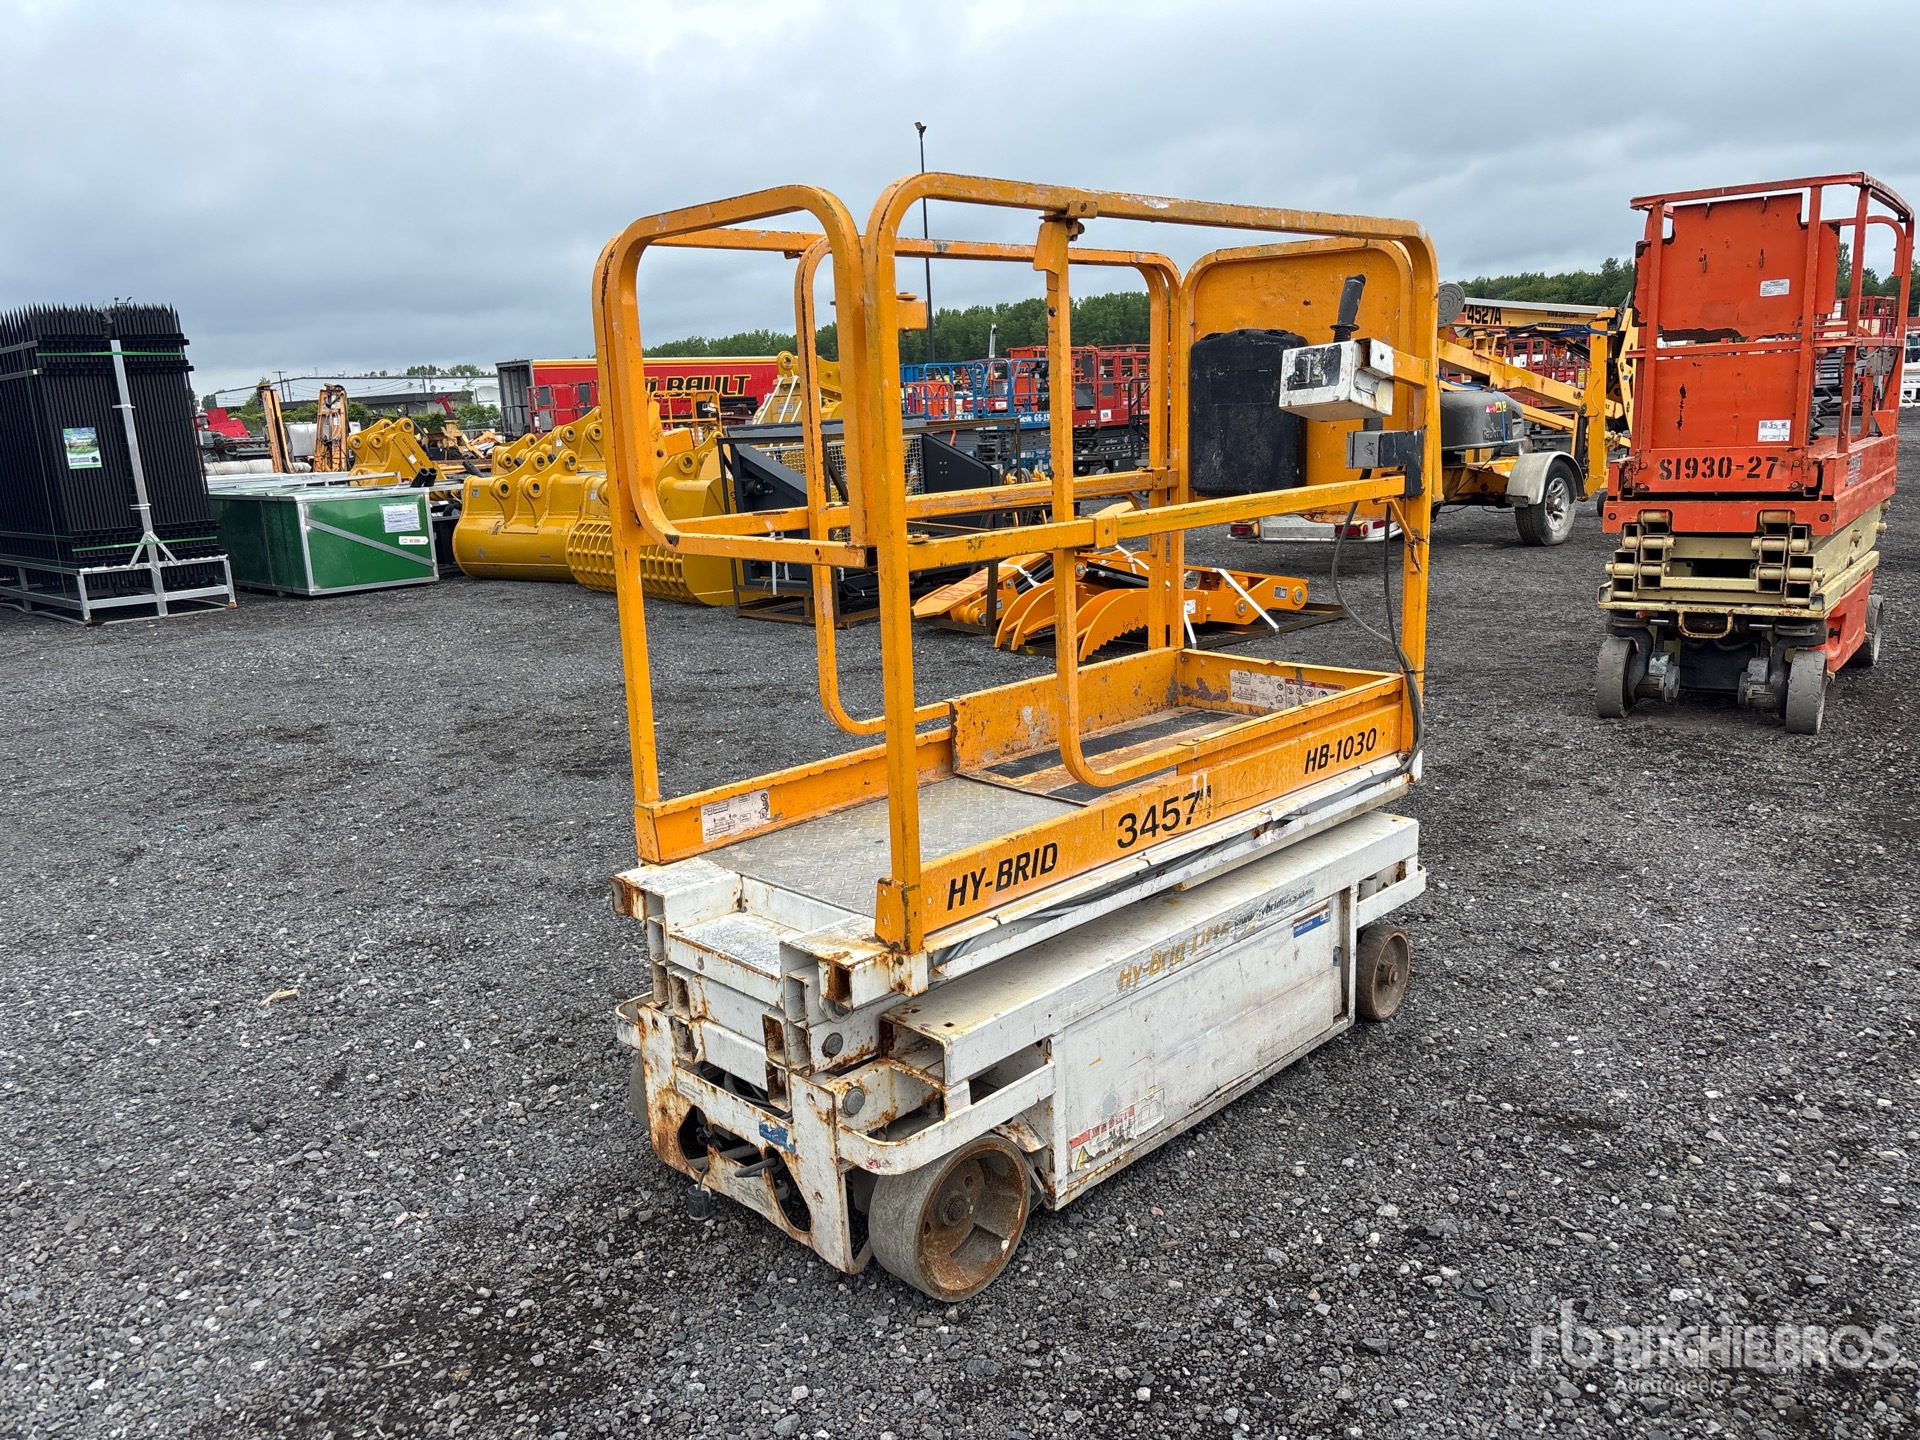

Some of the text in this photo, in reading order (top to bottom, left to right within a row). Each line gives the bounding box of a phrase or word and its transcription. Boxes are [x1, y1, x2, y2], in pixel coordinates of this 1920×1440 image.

[1466, 305, 1502, 325] 4527A
[1304, 728, 1377, 775] HB-1030
[1117, 790, 1202, 849] 3457
[947, 842, 1058, 912] HY-BRID
